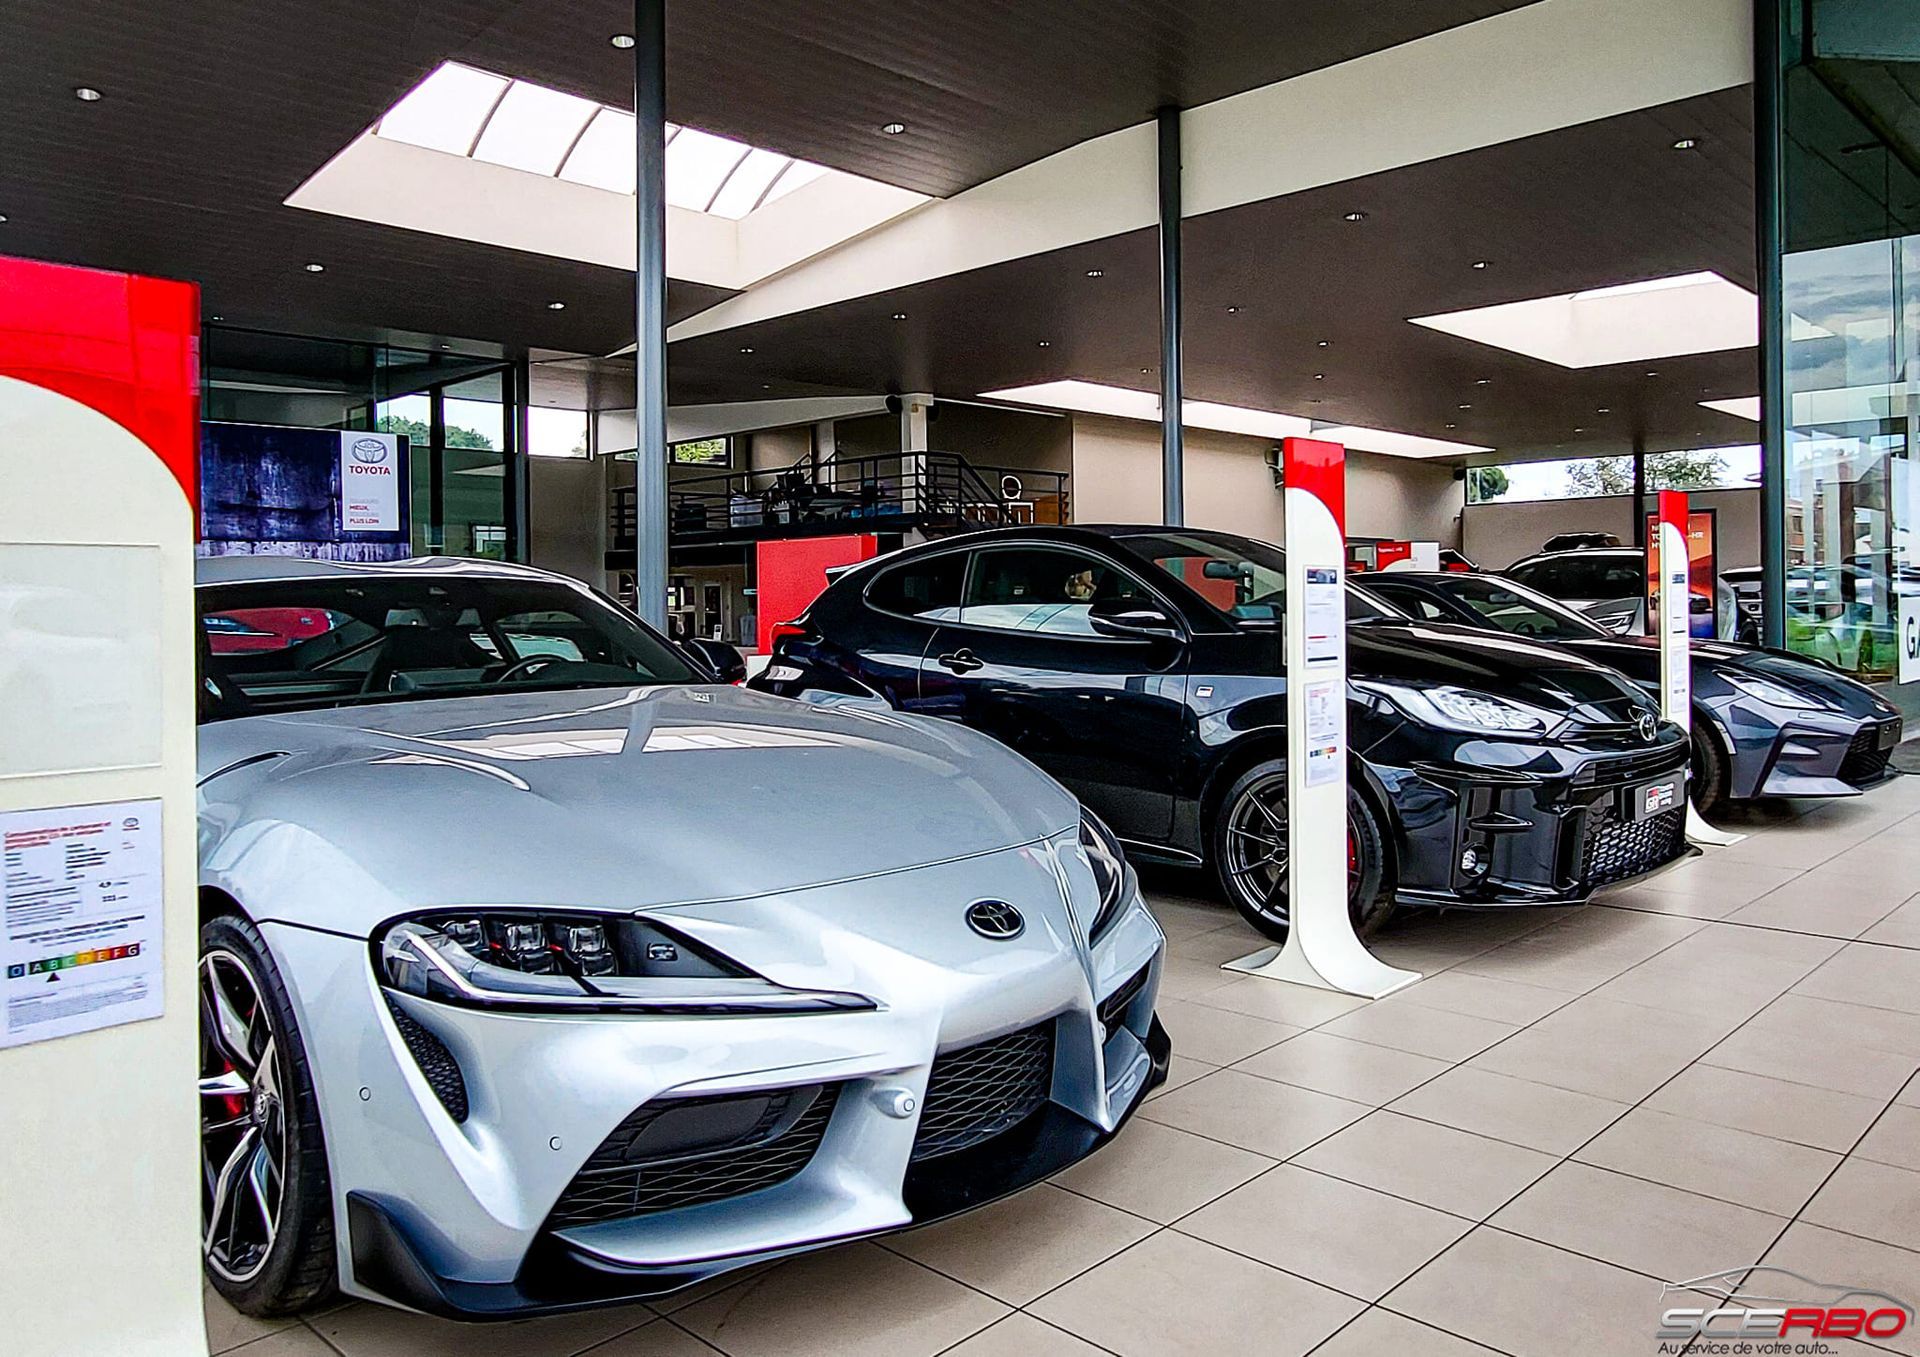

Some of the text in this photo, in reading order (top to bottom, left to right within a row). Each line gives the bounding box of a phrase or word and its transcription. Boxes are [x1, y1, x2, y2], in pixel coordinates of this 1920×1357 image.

[349, 465, 391, 475] TOYOTA
[32, 963, 43, 973] A
[49, 960, 58, 969] B
[97, 951, 105, 960] E
[113, 948, 121, 958] F
[127, 946, 138, 955] G
